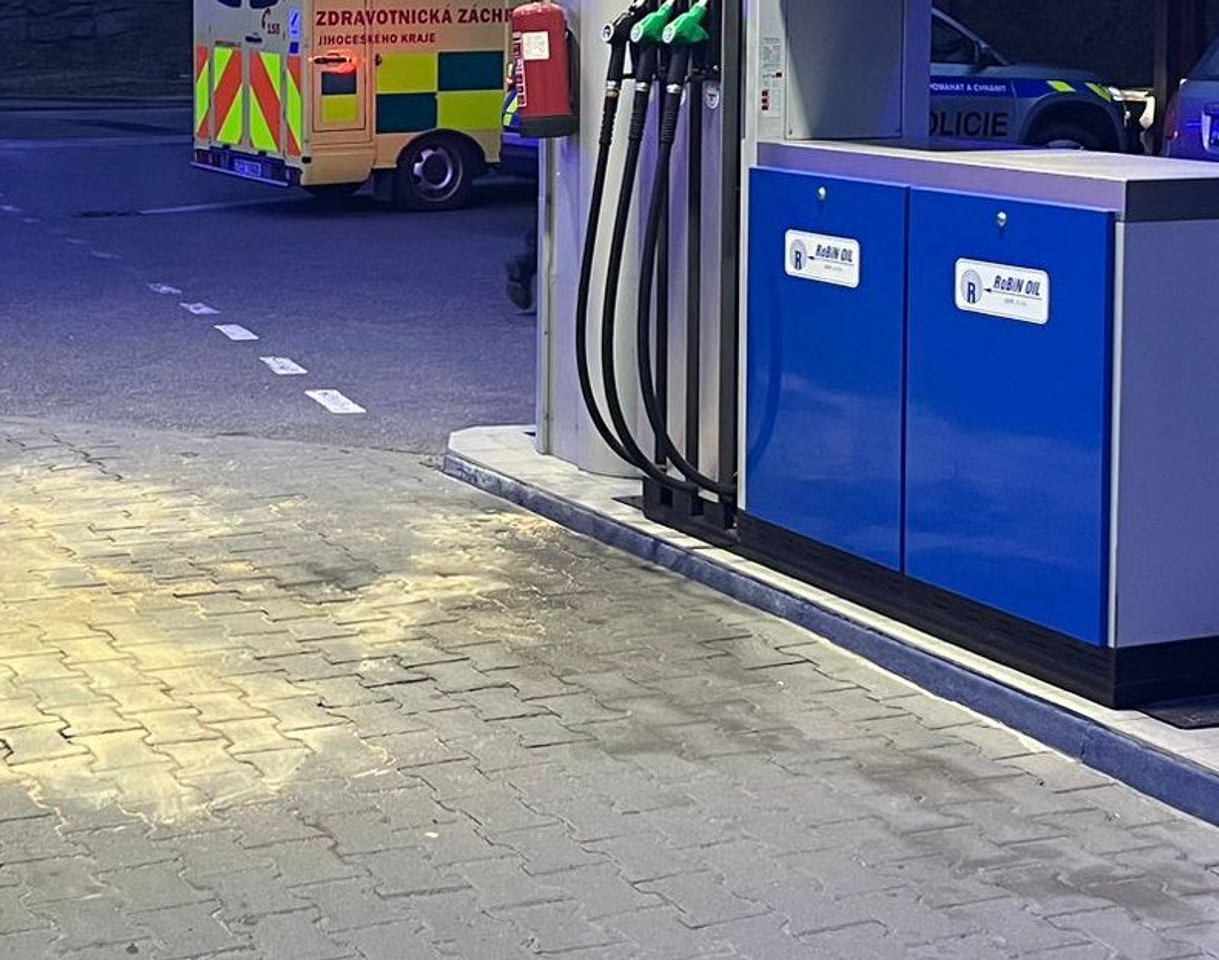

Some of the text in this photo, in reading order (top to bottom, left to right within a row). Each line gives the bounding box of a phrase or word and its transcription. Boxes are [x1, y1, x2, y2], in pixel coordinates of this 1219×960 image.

[316, 4, 452, 26] ZDRAVOTNICKÁ
[401, 32, 436, 44] KRAJE
[840, 247, 853, 263] OIL
[1025, 279, 1041, 296] OIL
